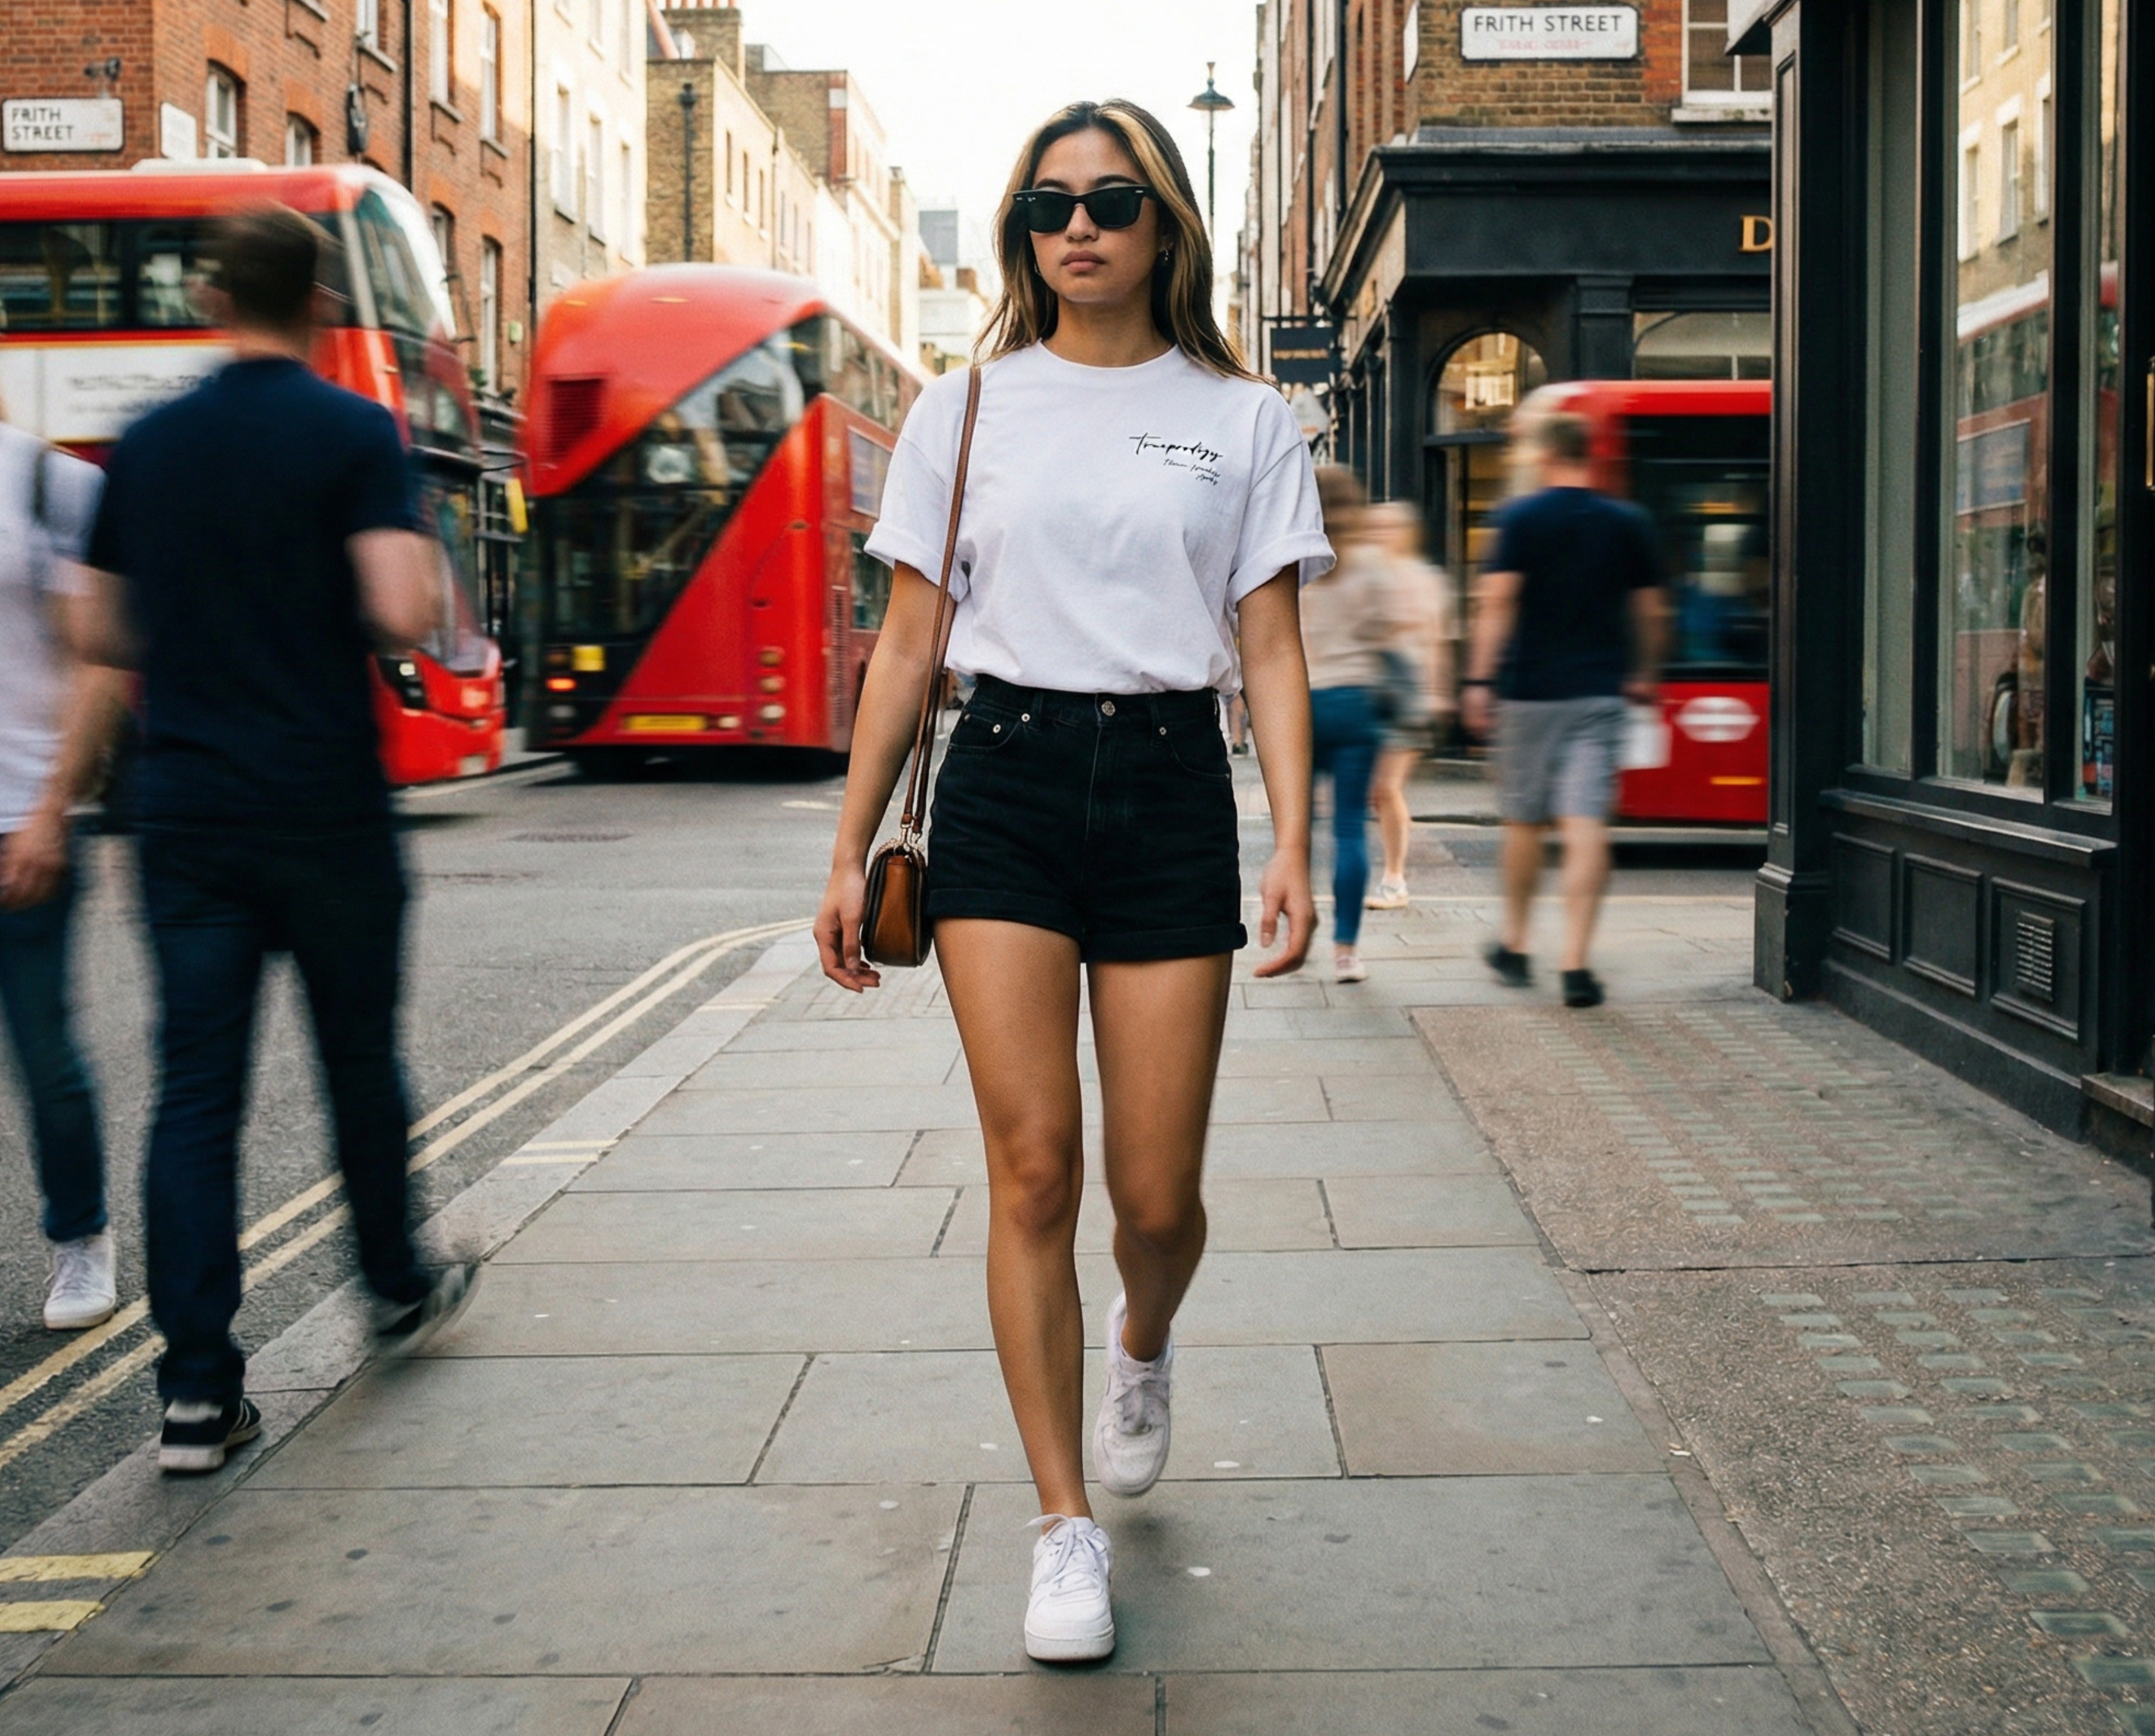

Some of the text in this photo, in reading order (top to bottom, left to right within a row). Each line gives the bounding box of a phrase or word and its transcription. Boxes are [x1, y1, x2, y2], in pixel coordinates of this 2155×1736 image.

[1474, 15, 1622, 32] FRITH STREET
[12, 107, 61, 122] FRITH
[12, 125, 74, 141] STREET
